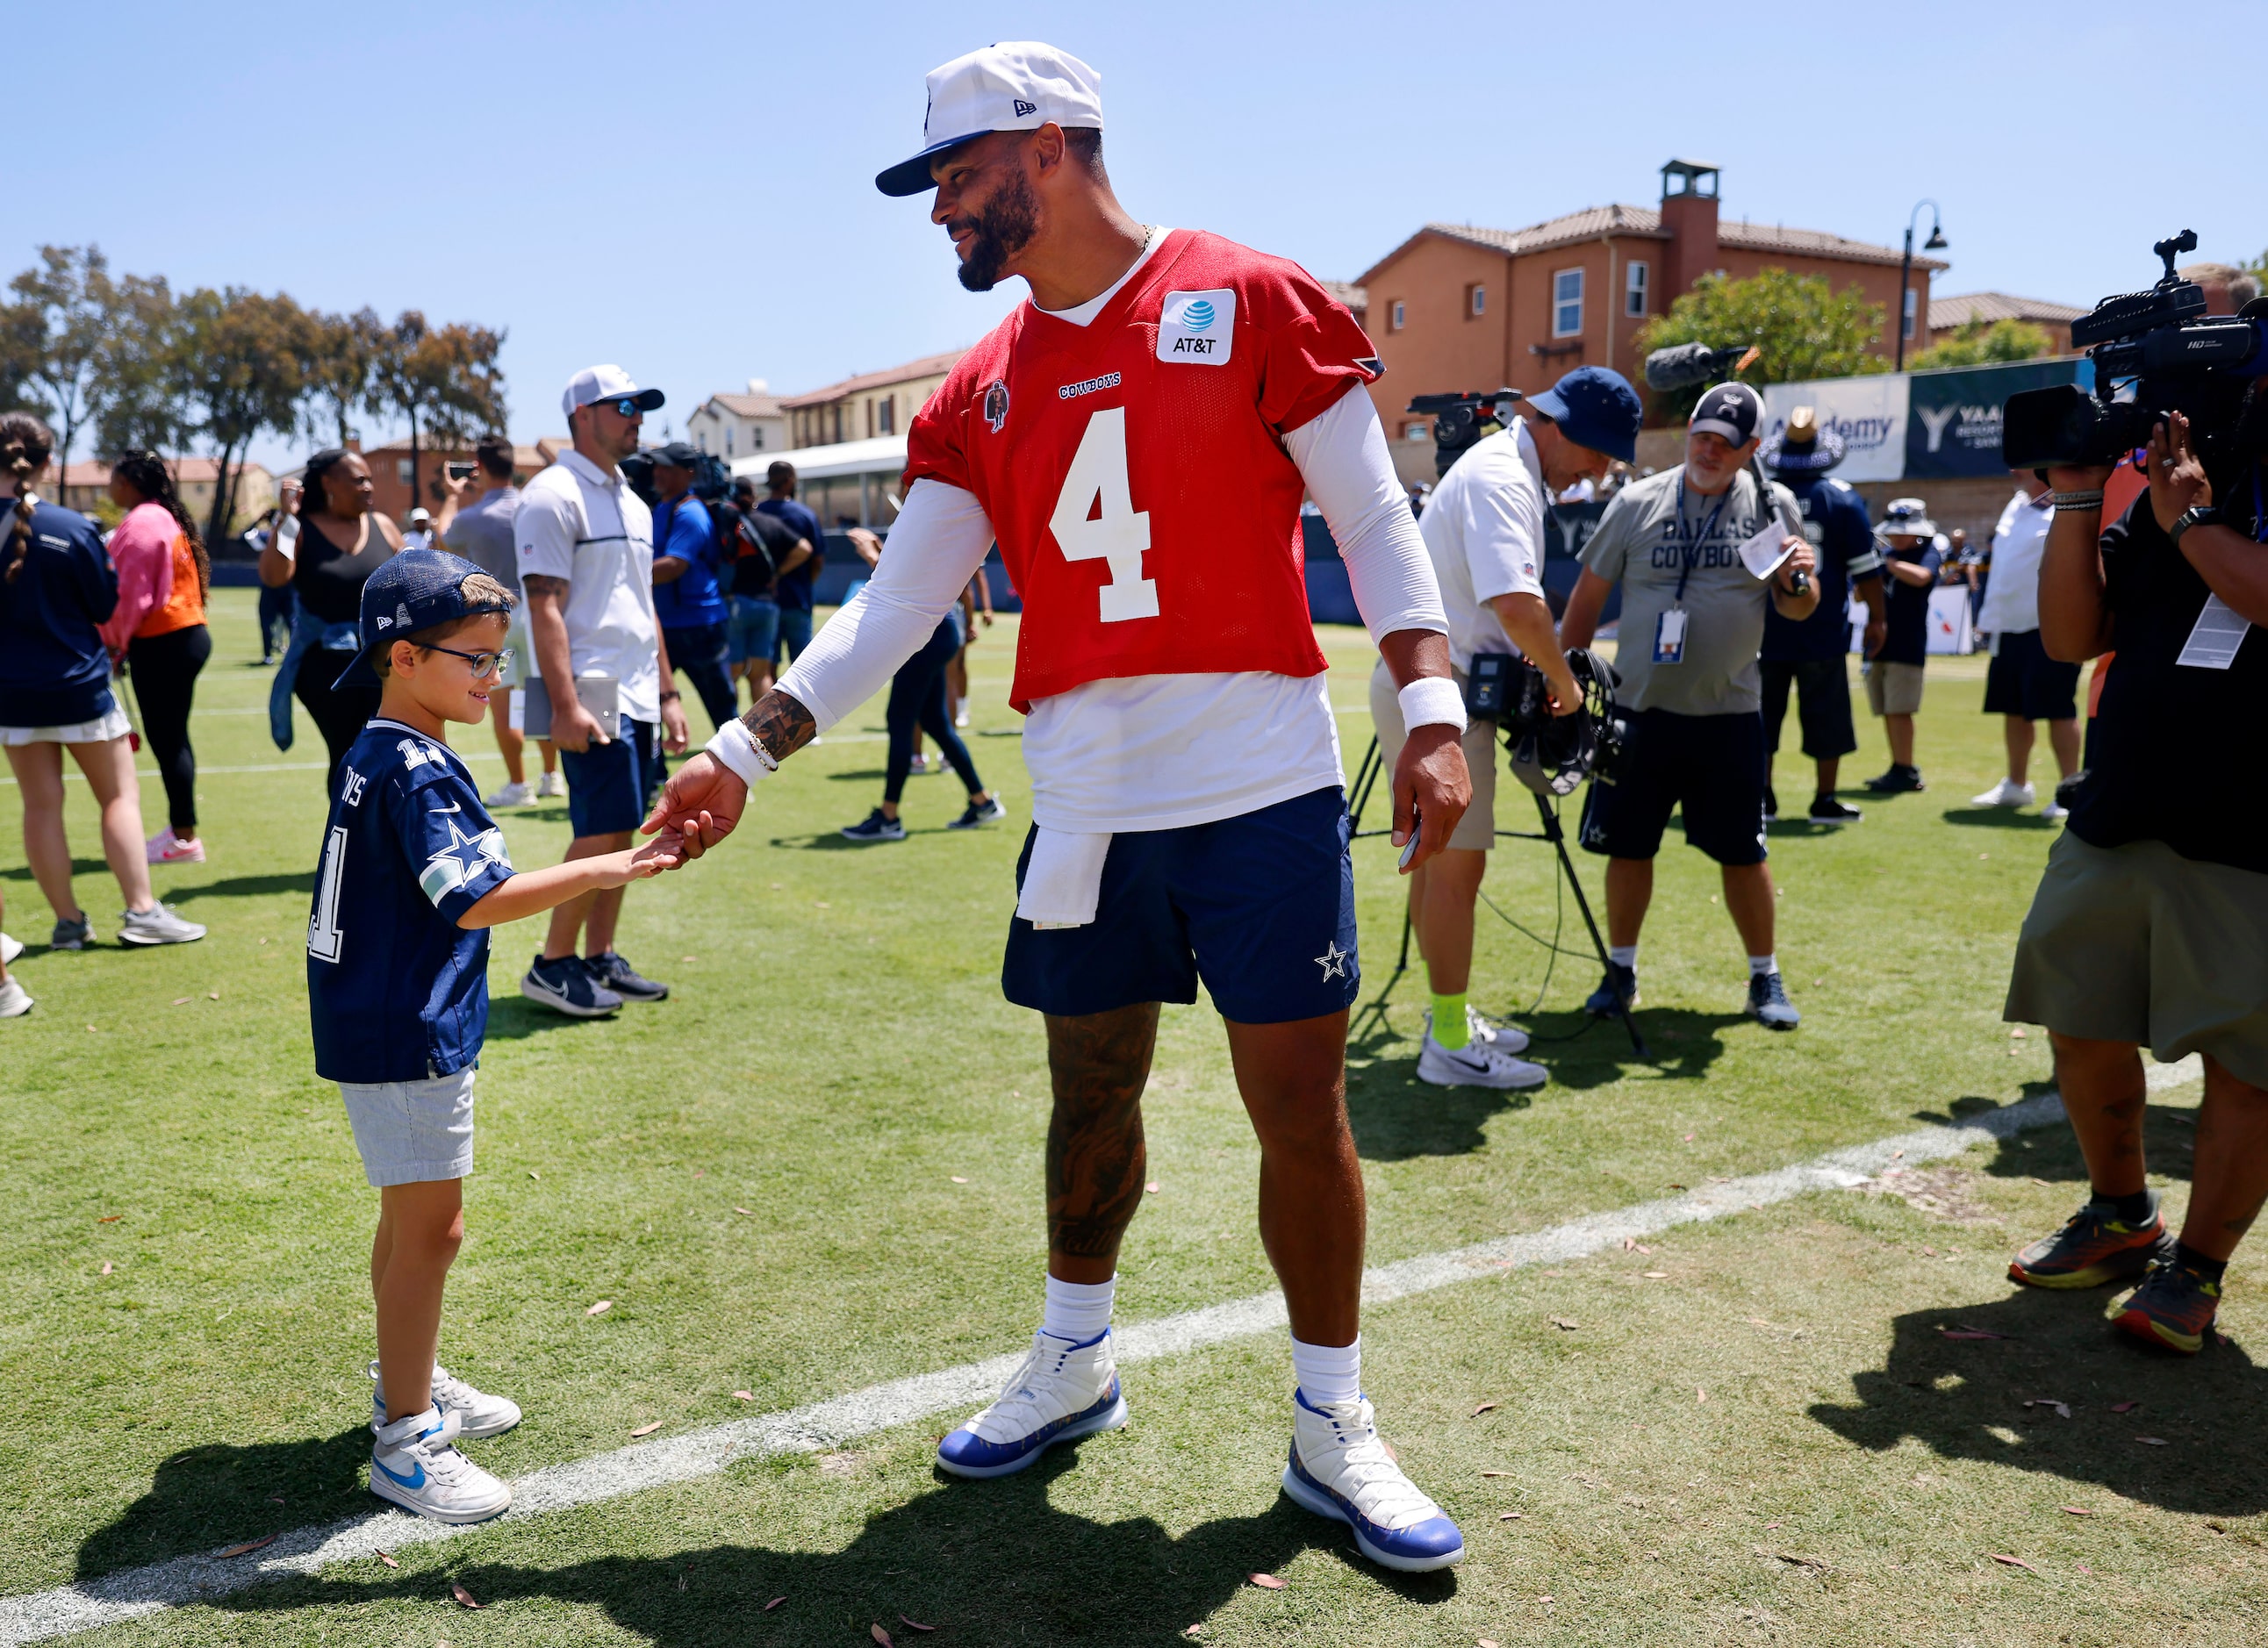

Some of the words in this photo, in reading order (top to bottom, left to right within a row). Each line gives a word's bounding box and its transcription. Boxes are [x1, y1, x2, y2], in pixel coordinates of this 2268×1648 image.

[1173, 337, 1217, 354] AT&T
[2186, 340, 2205, 350] HD
[1059, 371, 1122, 399] COWBOYS
[1959, 405, 2003, 422] YAA
[1769, 415, 1893, 447] Ademy
[1048, 405, 1160, 622] 4
[1662, 518, 1755, 541] DALLAS
[1651, 545, 1749, 570] COWBO
[396, 738, 447, 771] 11
[307, 825, 348, 964] 1
